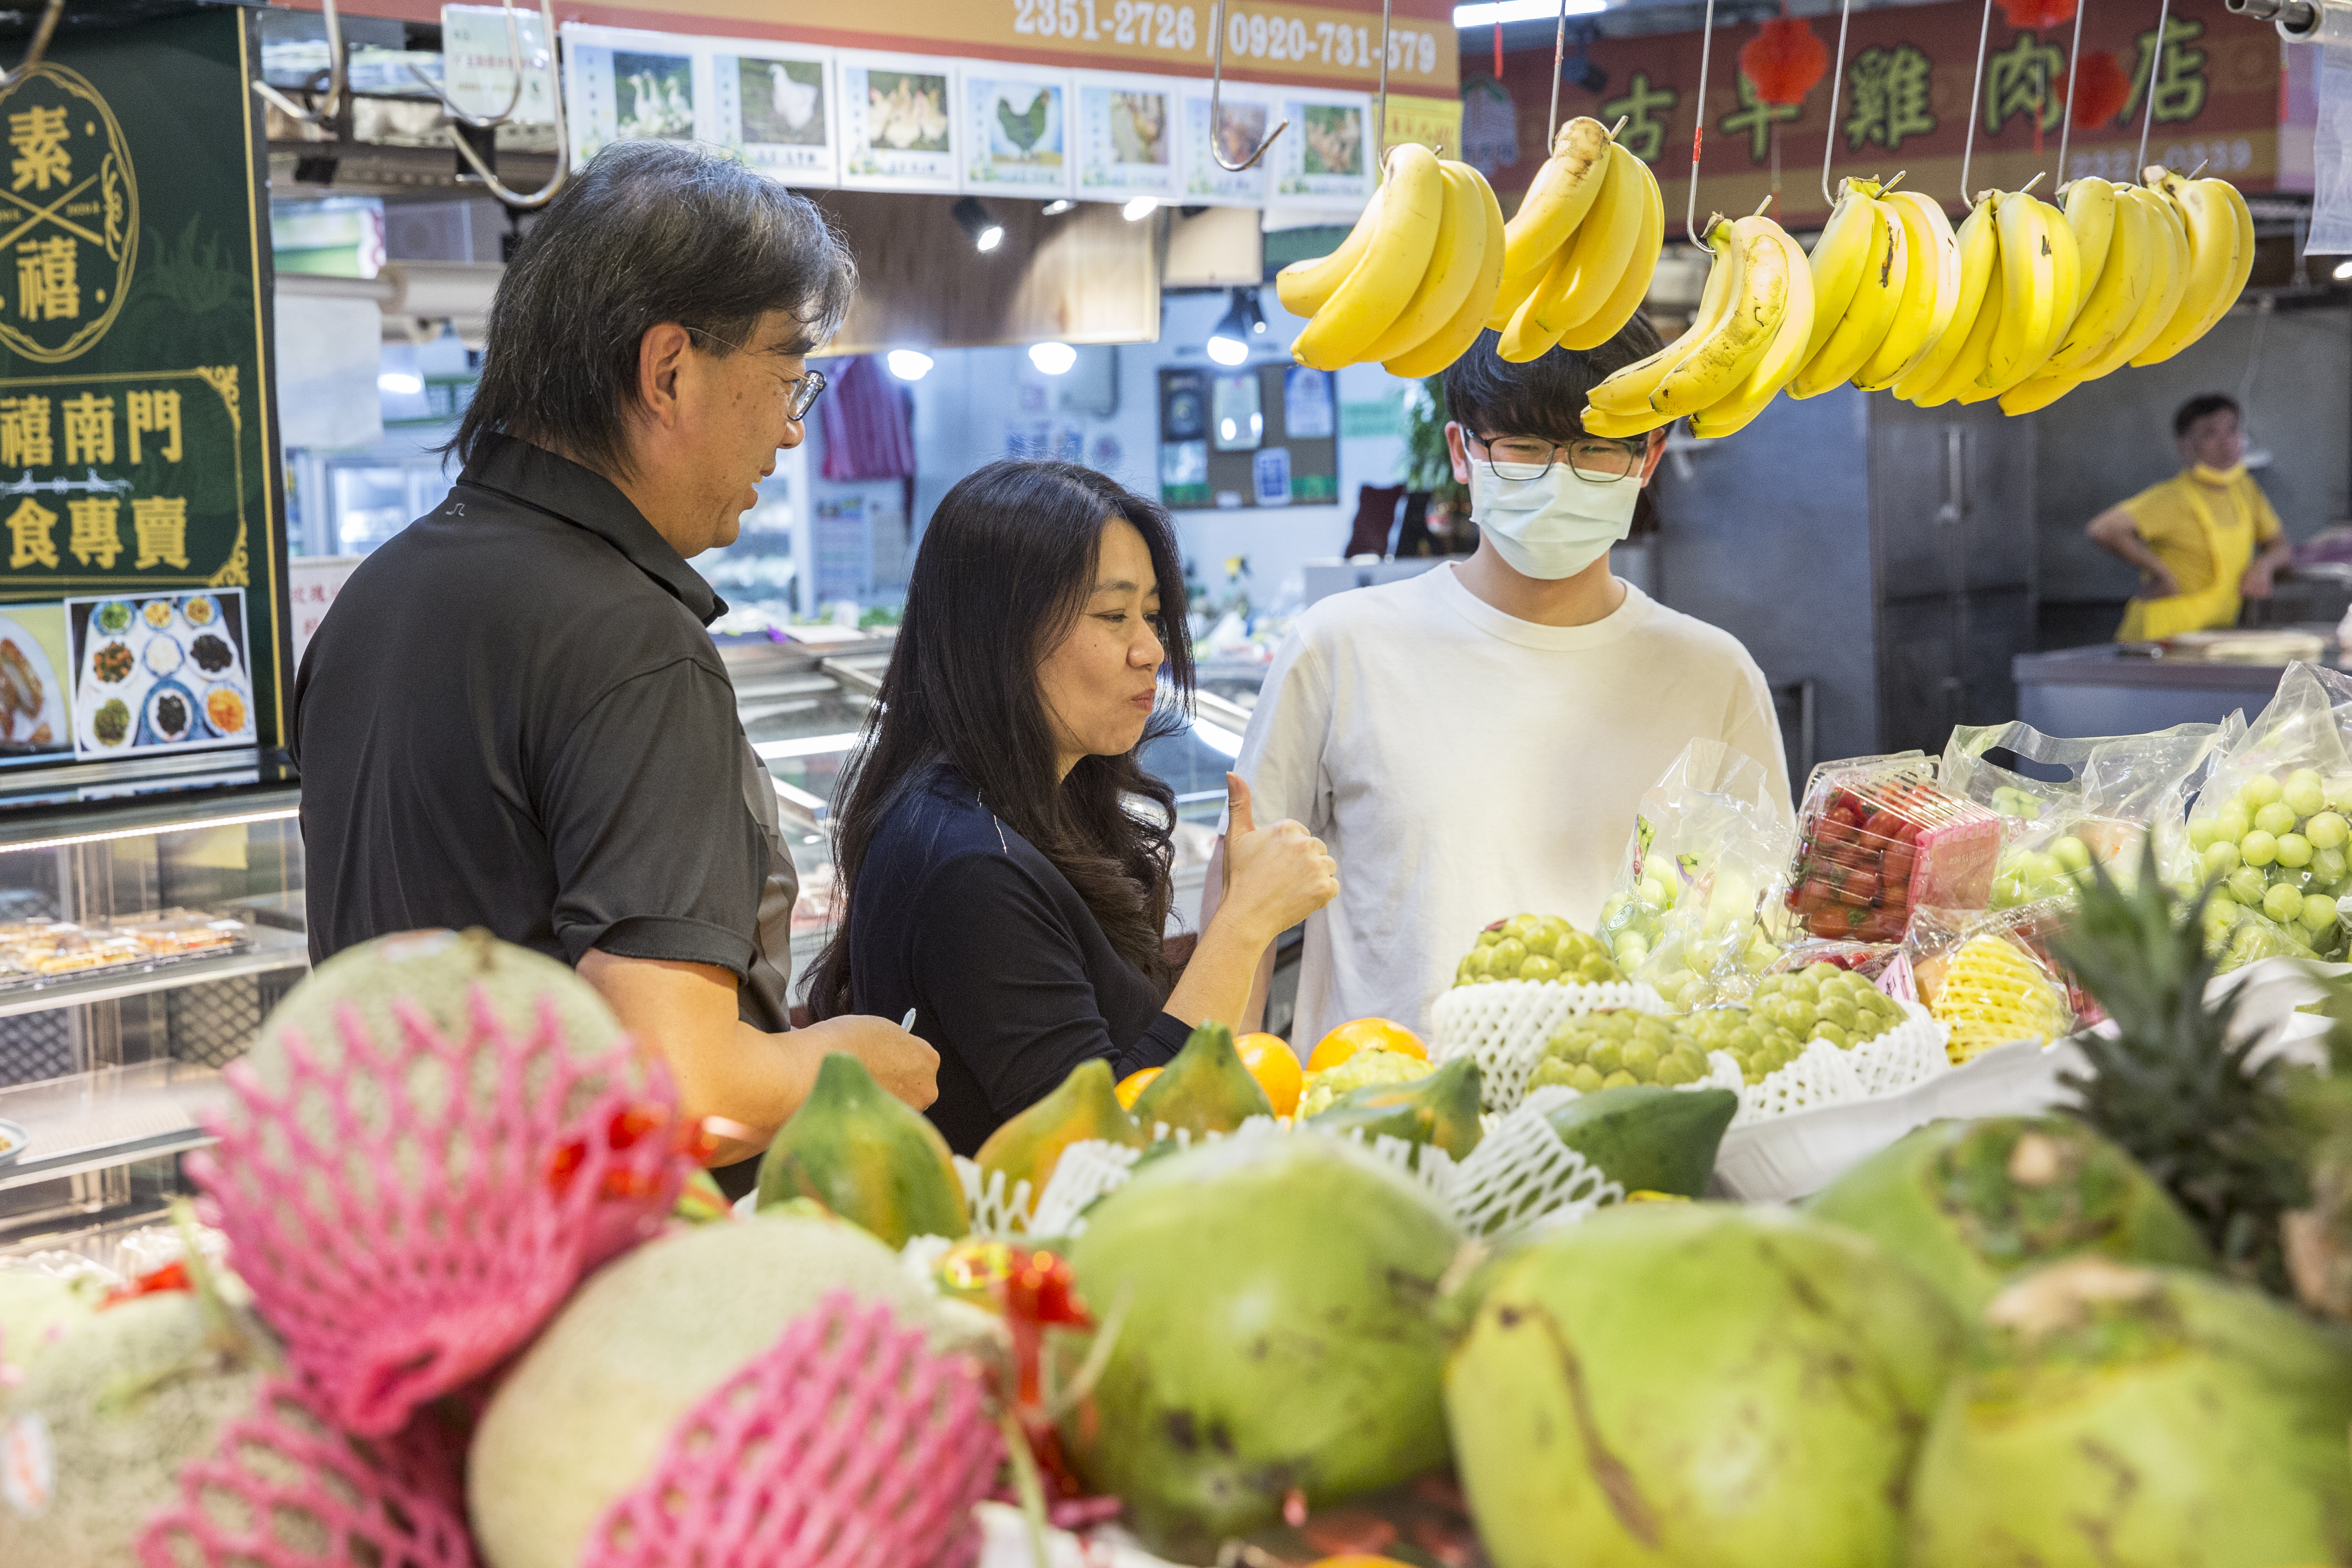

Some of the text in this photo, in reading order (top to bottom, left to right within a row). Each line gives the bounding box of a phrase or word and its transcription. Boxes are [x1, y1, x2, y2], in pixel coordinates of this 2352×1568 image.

[1014, 0, 1196, 51] 2351-2726
[1228, 11, 1436, 74] 0920-731-579
[4, 496, 191, 571] 食專賣
[1618, 909, 1629, 922] PLU
